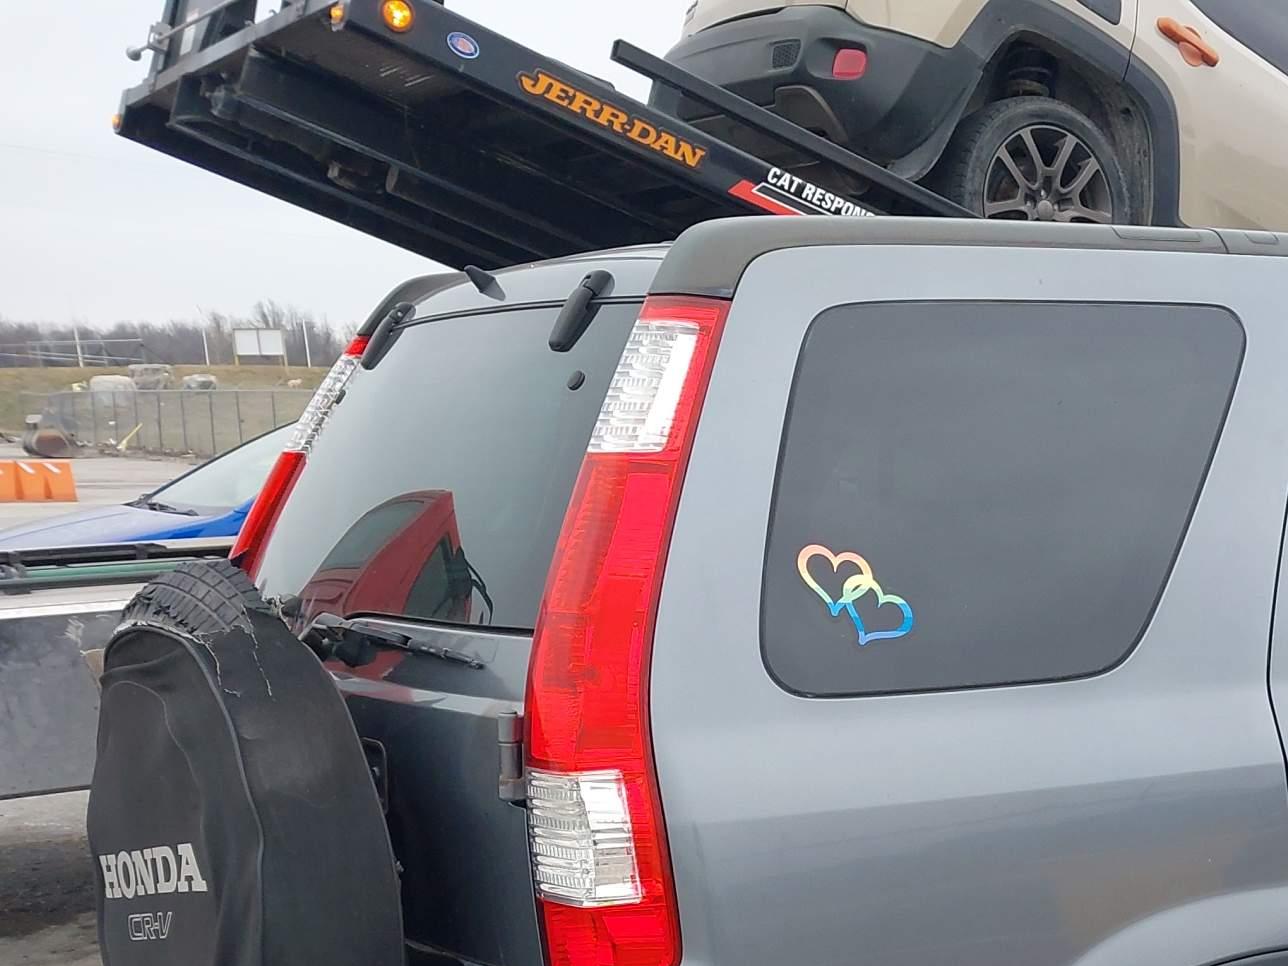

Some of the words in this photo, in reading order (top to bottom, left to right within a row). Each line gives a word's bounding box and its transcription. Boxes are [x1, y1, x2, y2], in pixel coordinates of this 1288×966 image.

[518, 70, 706, 169] JERR-DAN
[767, 167, 803, 193] CAT
[801, 183, 877, 216] RESPON
[99, 843, 208, 899] HONDA
[128, 911, 173, 941] CR-V
